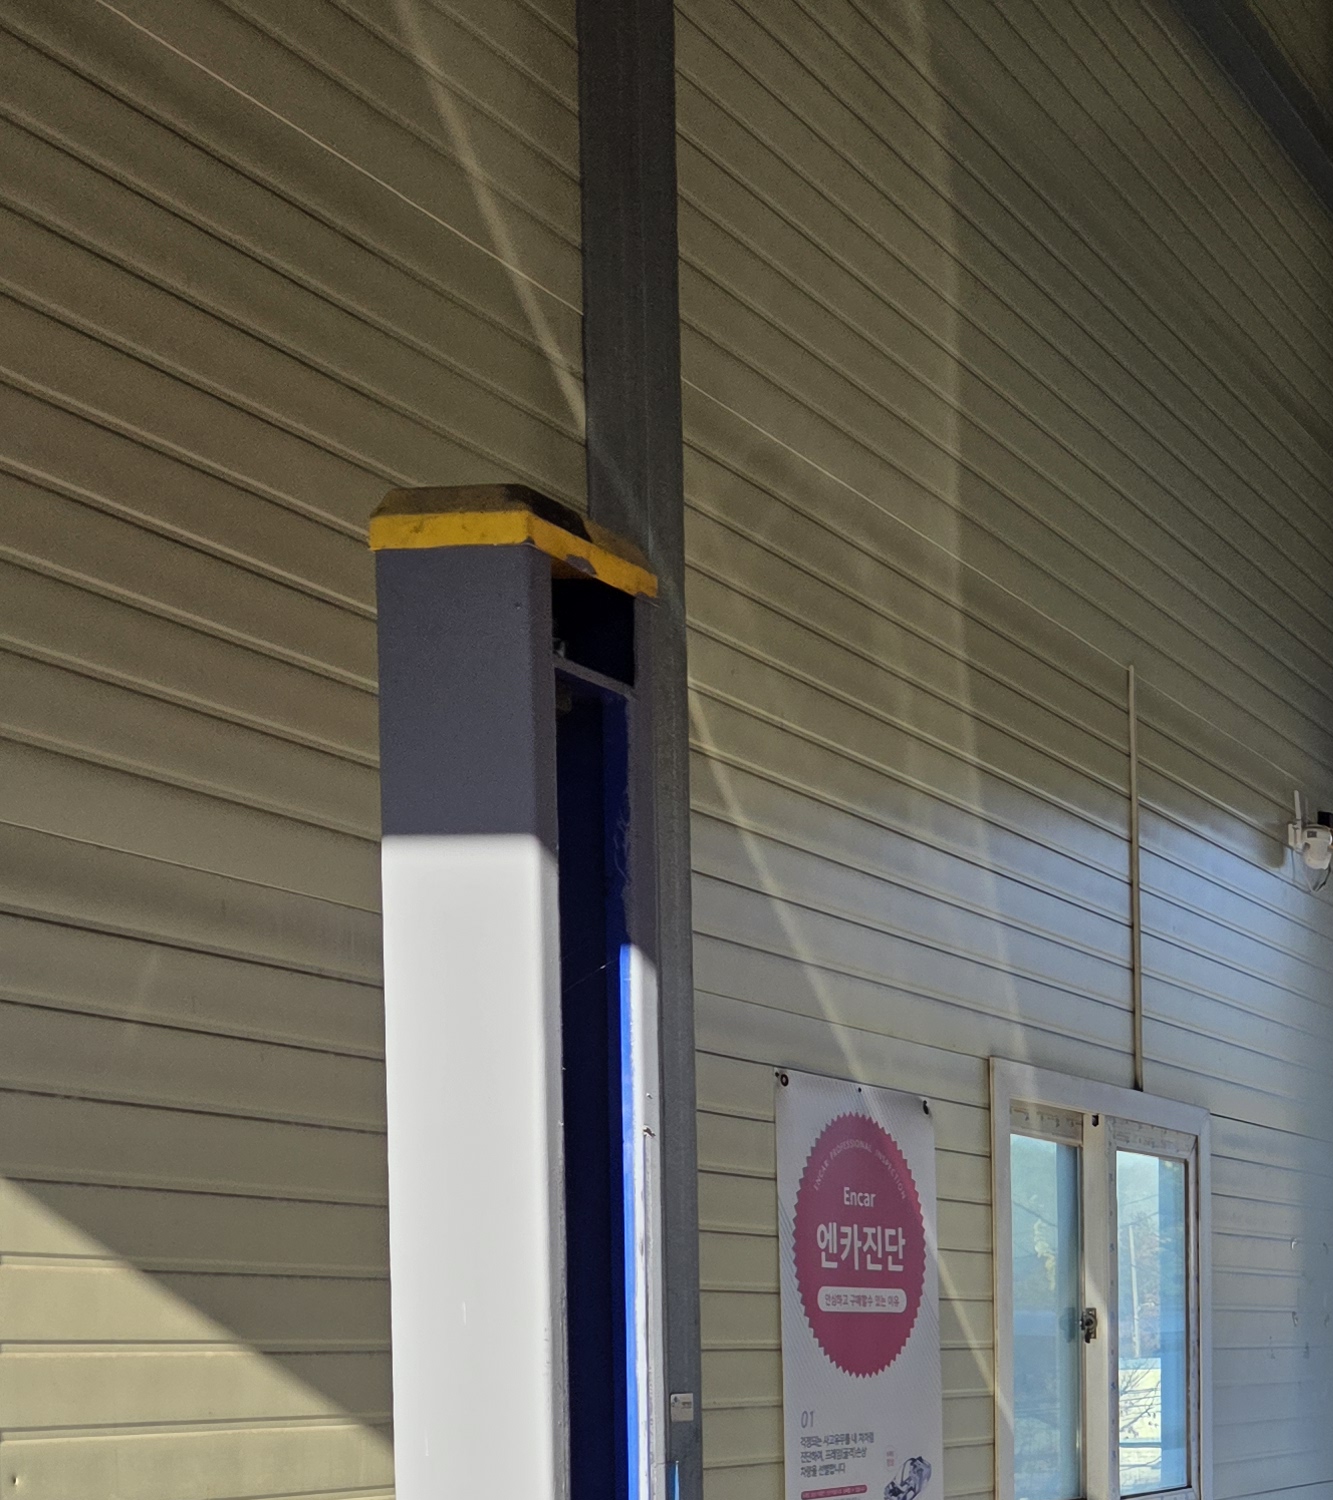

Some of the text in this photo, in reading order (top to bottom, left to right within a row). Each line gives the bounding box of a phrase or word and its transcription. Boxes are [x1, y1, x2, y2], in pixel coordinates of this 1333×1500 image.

[843, 1186, 876, 1208] Encar
[816, 1222, 906, 1272] 엔카진단
[825, 1293, 849, 1307] 안심하고
[875, 1294, 888, 1308] 있는
[801, 1410, 815, 1428] 01
